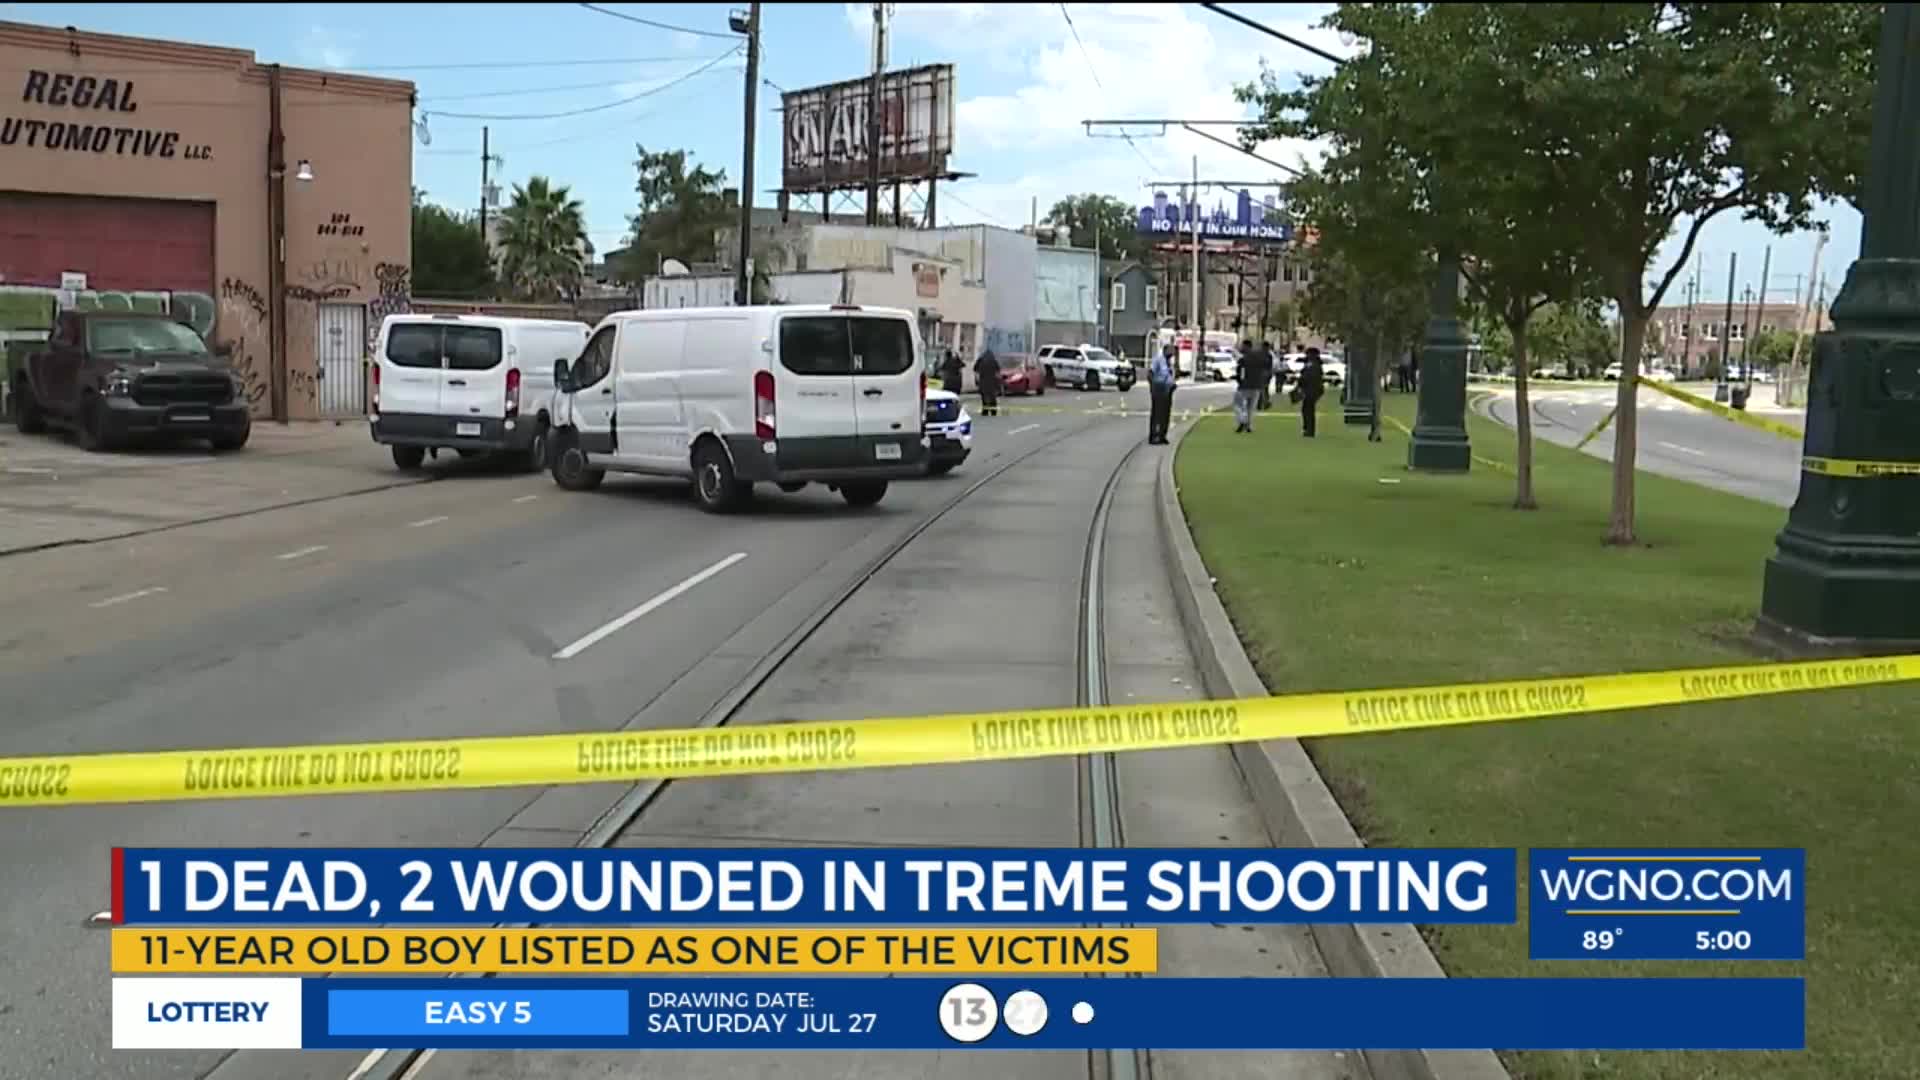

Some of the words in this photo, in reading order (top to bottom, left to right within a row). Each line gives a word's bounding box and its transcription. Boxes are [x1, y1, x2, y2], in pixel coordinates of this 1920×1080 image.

[22, 69, 137, 112] REGAL
[1152, 219, 1171, 232] NO
[1206, 223, 1220, 235] IN
